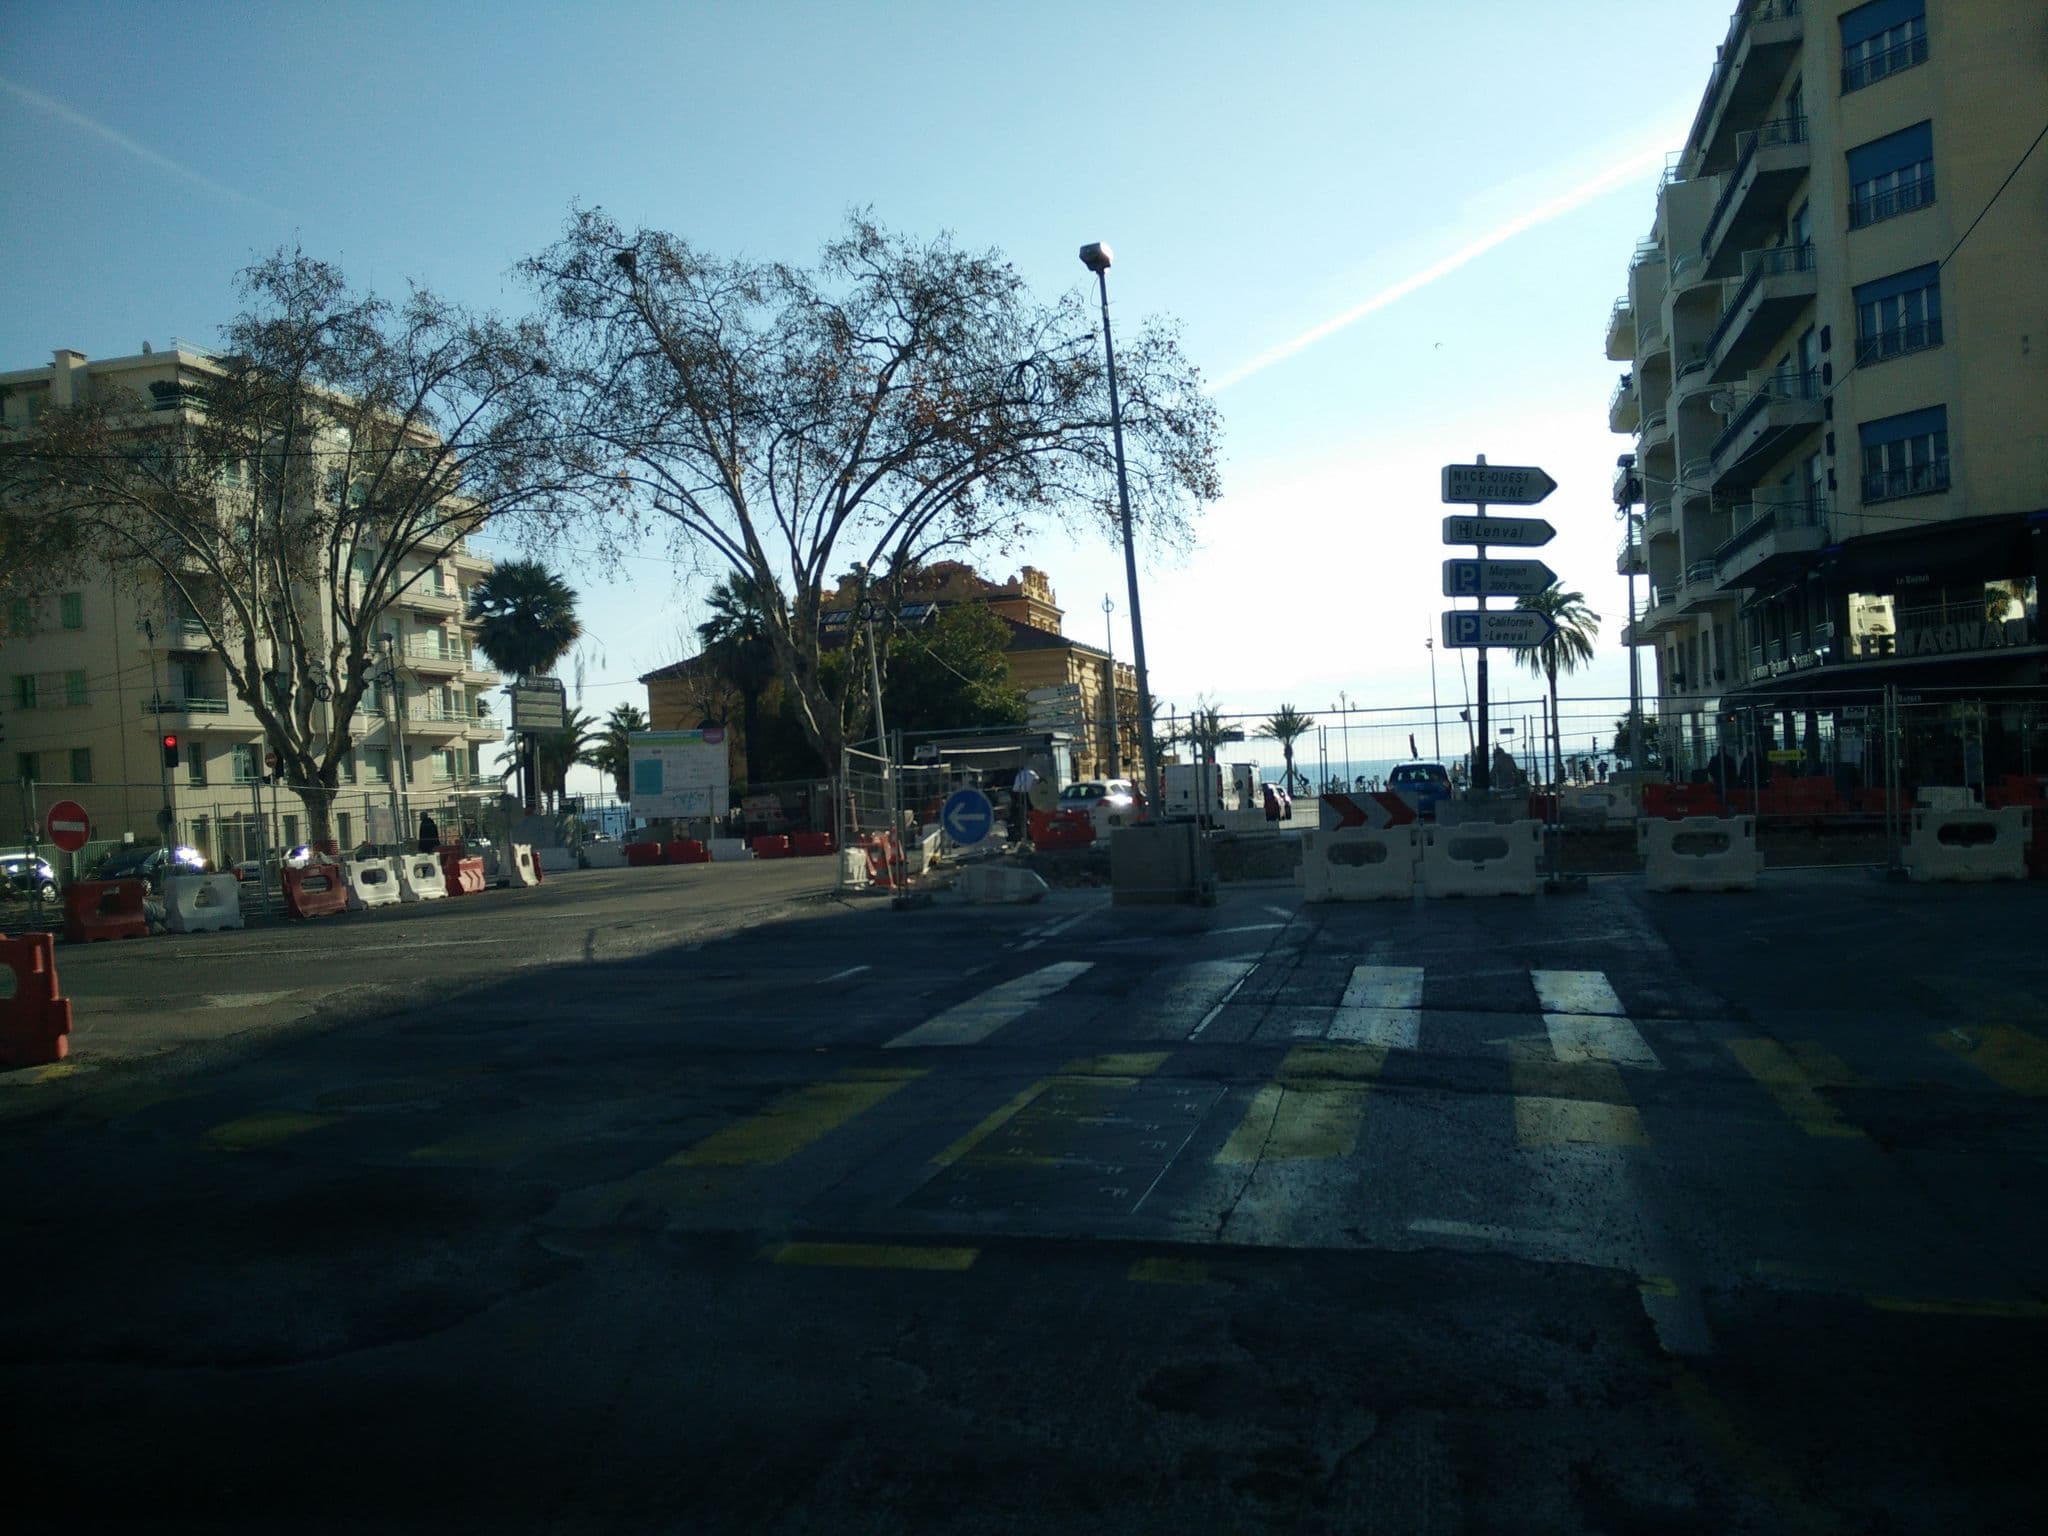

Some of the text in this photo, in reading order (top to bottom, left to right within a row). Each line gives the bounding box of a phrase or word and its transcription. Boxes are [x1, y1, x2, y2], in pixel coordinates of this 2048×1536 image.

[1454, 471, 1529, 483] NICE-OUEST
[1475, 523, 1524, 538] Lenval
[1460, 564, 1476, 591] P
[1460, 616, 1477, 642] P
